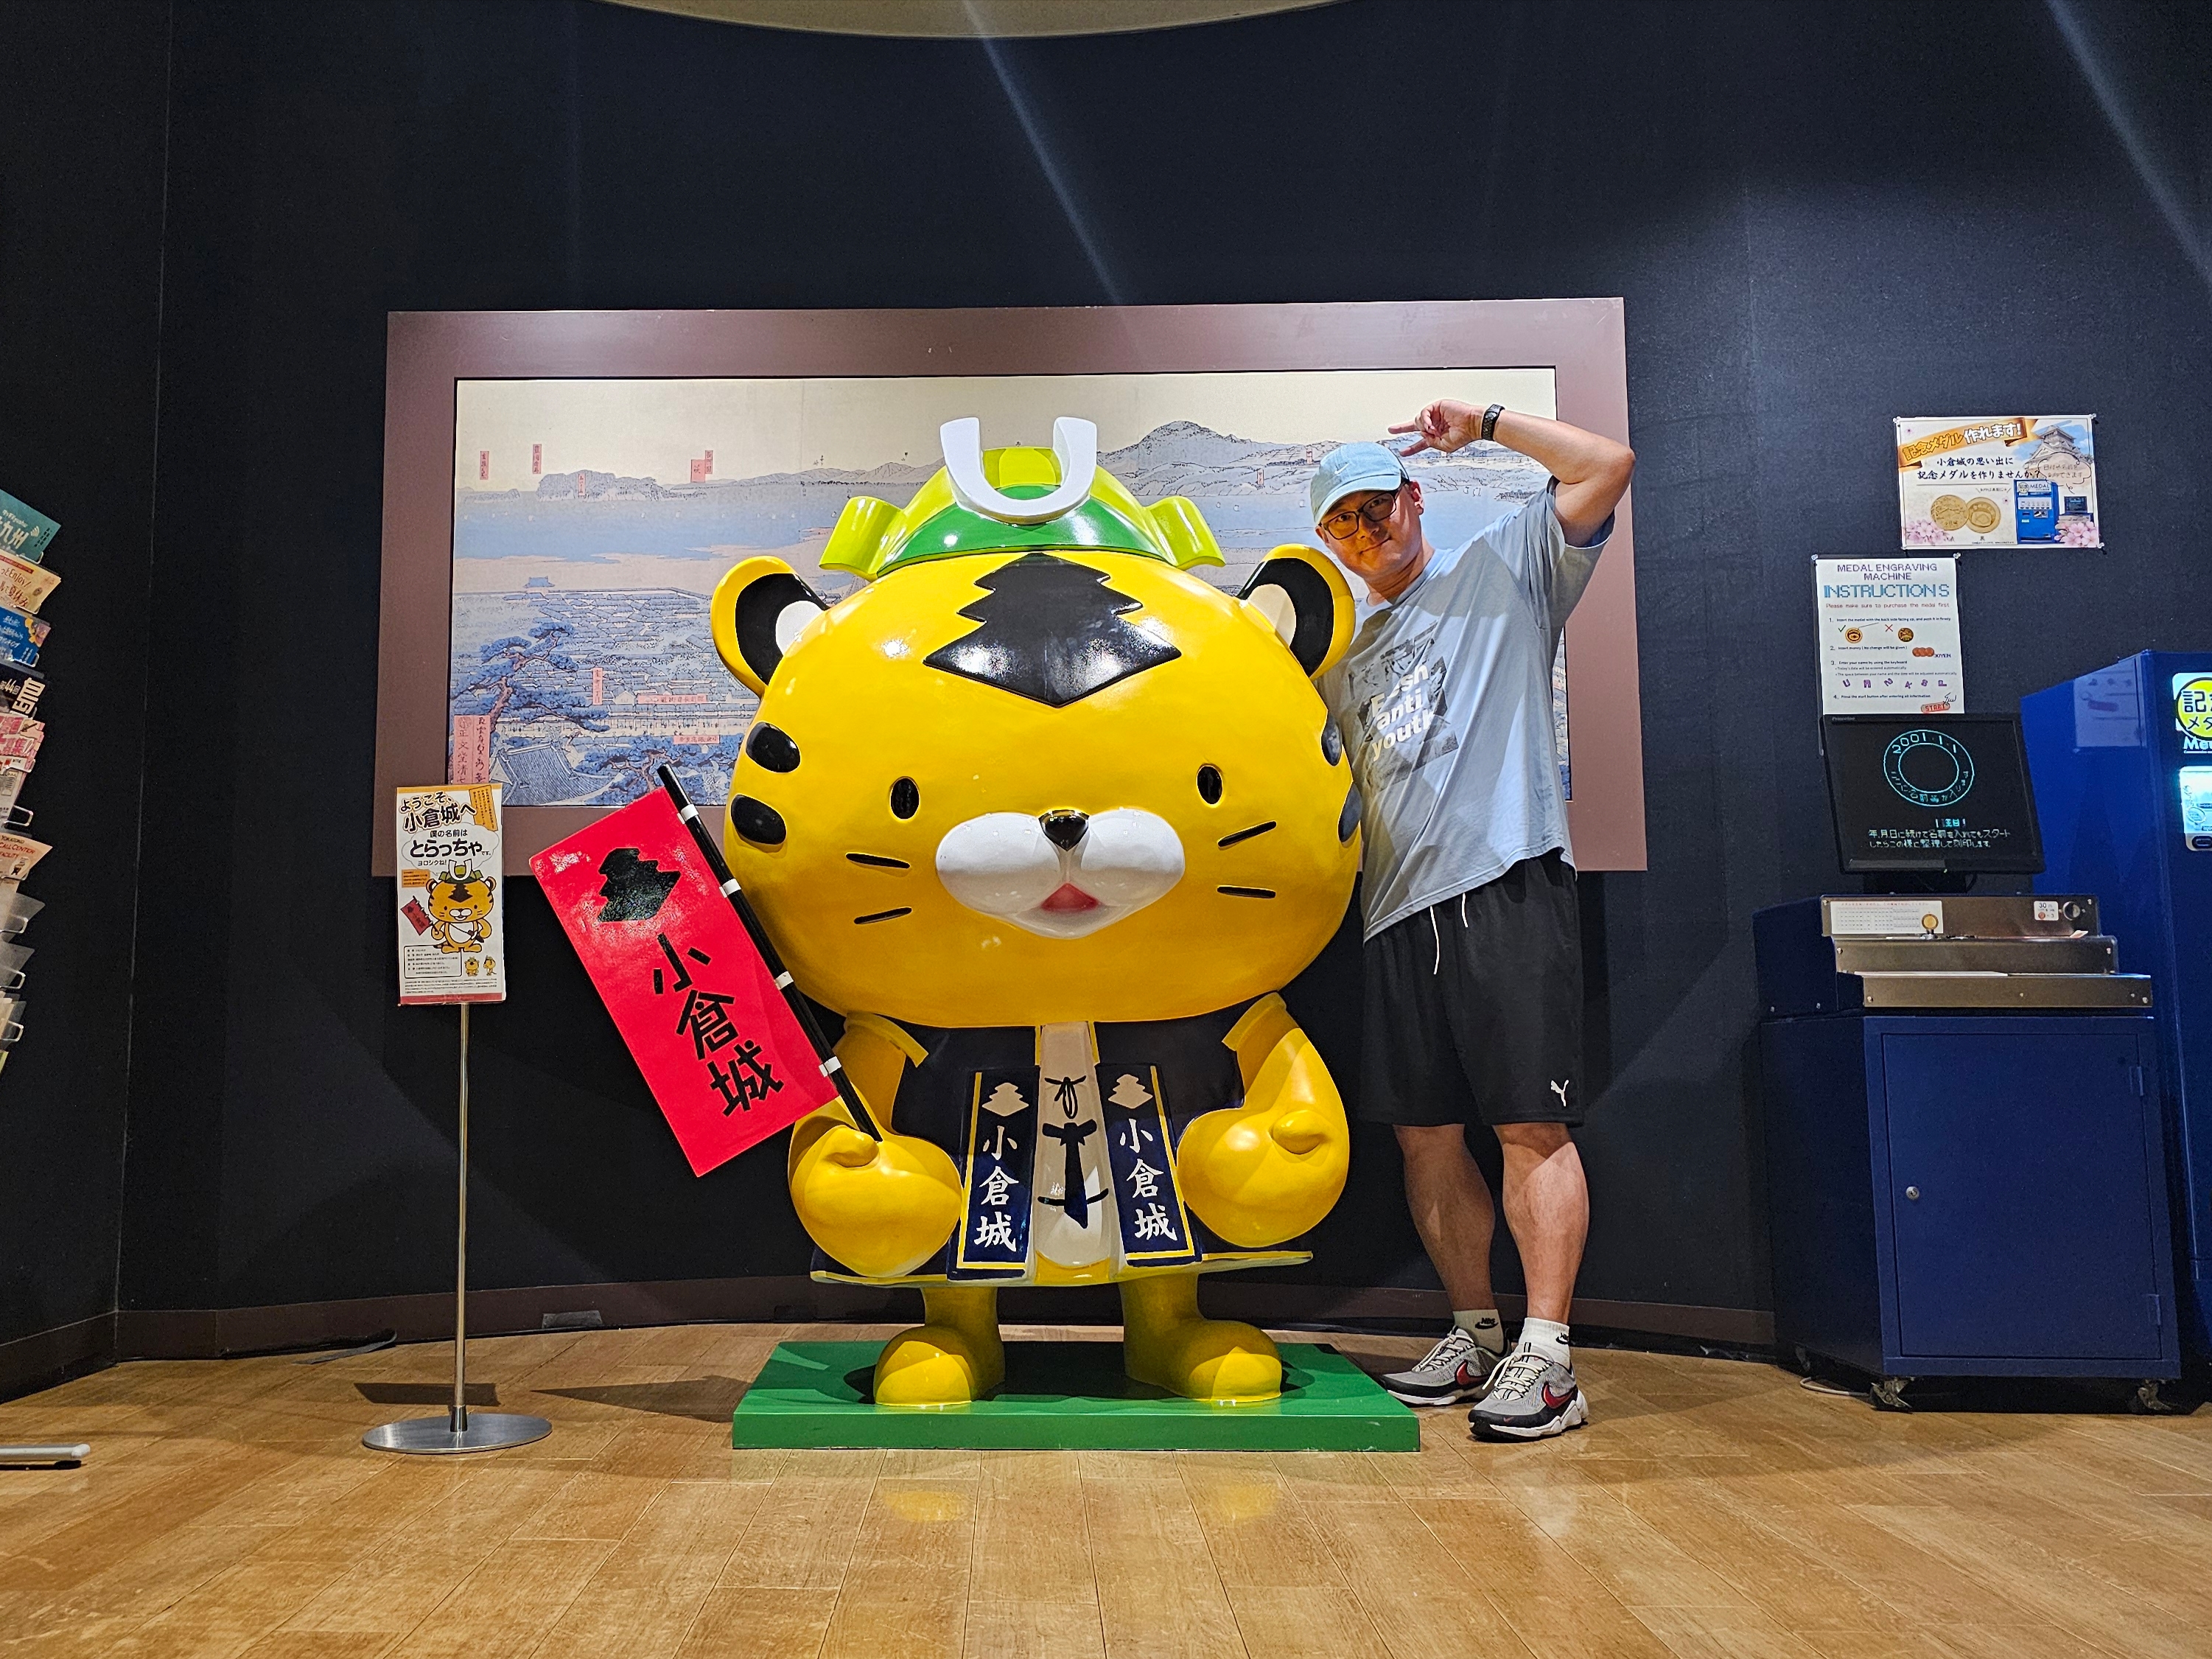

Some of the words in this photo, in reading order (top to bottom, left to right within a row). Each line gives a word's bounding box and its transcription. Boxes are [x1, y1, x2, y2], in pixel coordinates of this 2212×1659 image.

[1936, 457, 2014, 466] 小倉城の思い出に
[1837, 564, 1873, 572] MEDAL
[1876, 563, 1937, 571] ENGRAVING
[1824, 584, 1950, 598] INSTRUCTIONS
[1376, 688, 1423, 730] anti
[2183, 691, 2212, 713] 記
[1372, 708, 1436, 761] youth
[400, 791, 452, 812] ようこそ、
[405, 802, 476, 832] 小倉城へ
[430, 829, 468, 838] 僕の名前は
[653, 932, 784, 1117] 小倉城
[973, 1125, 1019, 1252] 小倉城
[1119, 1118, 1178, 1241] 小倉城
